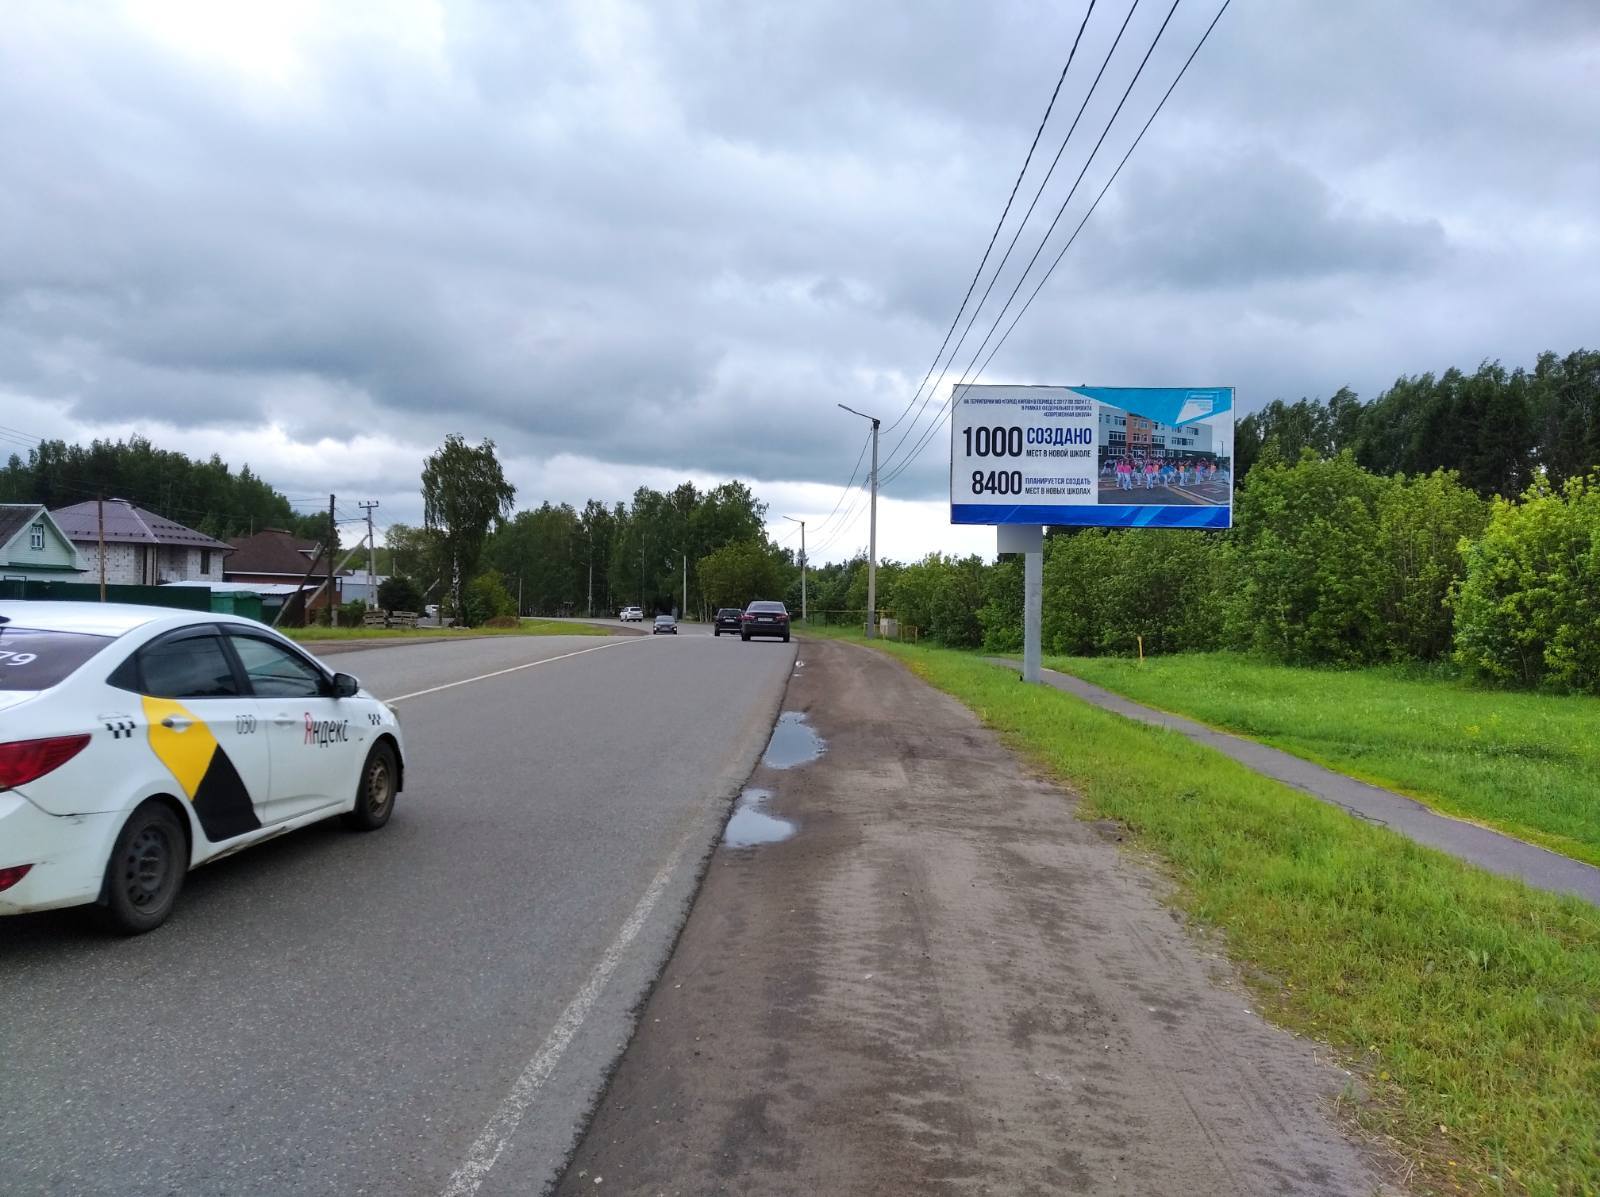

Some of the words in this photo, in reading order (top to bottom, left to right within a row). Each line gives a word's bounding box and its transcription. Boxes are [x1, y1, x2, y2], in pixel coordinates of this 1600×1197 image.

[963, 426, 1023, 457] 1000
[1027, 427, 1092, 446] СОЗДАНО
[1026, 449, 1042, 457] МЕСТ
[1043, 449, 1047, 457] В
[1048, 448, 1068, 457] НОВОЙ
[1069, 449, 1091, 457] ШКОЛЕ
[972, 471, 1022, 495] 8400
[1025, 477, 1064, 485] ПЛАНИРУЕТСЯ
[1065, 477, 1091, 486] СОЗДАТЬ
[1025, 487, 1039, 495] МЕСТ
[1040, 487, 1044, 495] В
[1046, 487, 1065, 495] НОВЫХ
[1067, 487, 1091, 495] ШКОЛАХ
[304, 712, 348, 748] Яндекс
